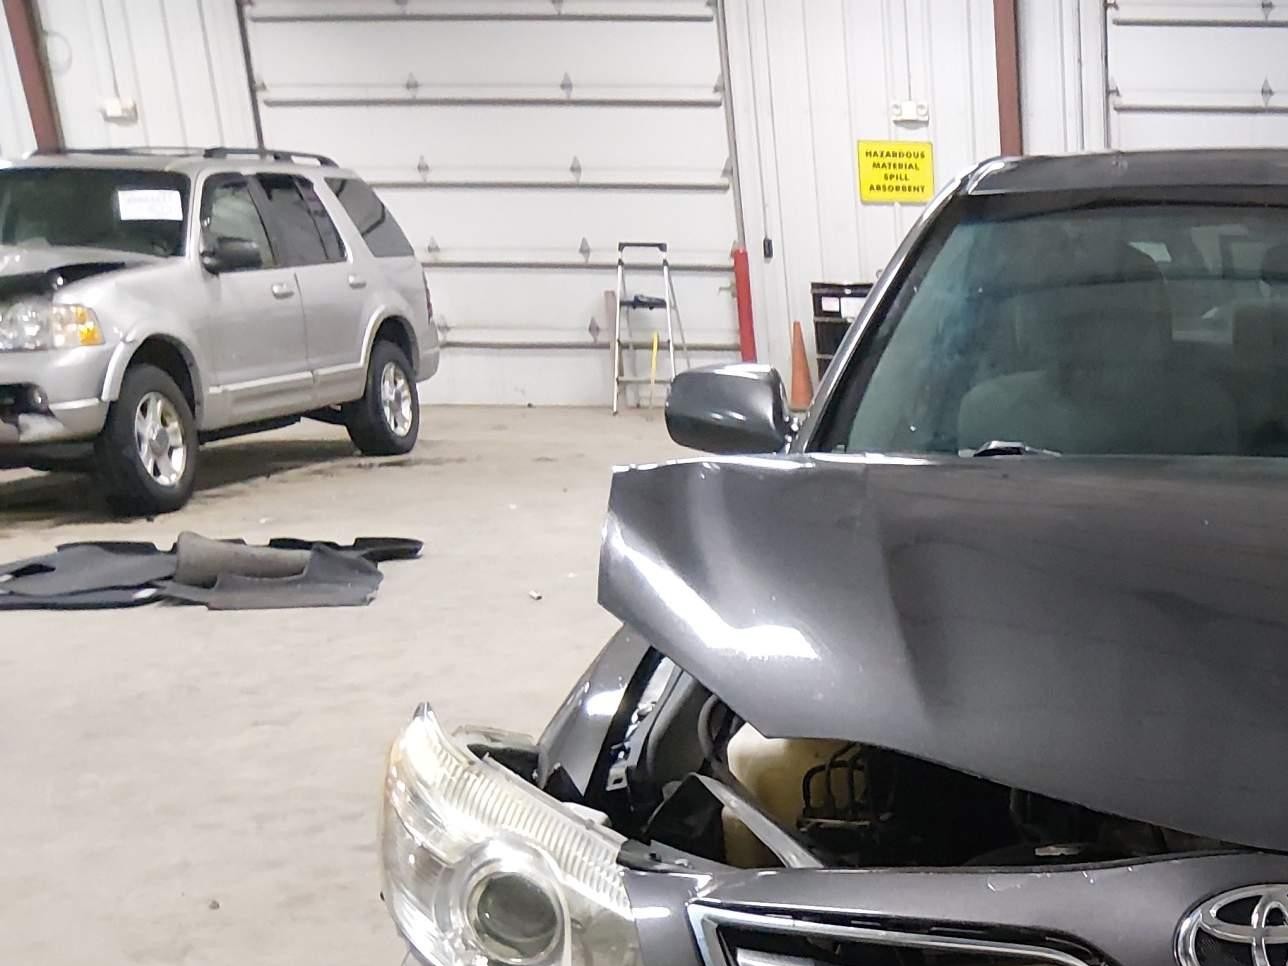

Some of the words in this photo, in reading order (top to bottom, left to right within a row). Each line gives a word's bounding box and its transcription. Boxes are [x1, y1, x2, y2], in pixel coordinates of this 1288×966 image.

[865, 150, 925, 159] HAZARDOUS
[872, 162, 920, 171] MATERIAL
[883, 173, 910, 181] SPILL
[869, 184, 925, 193] ABSORBENT
